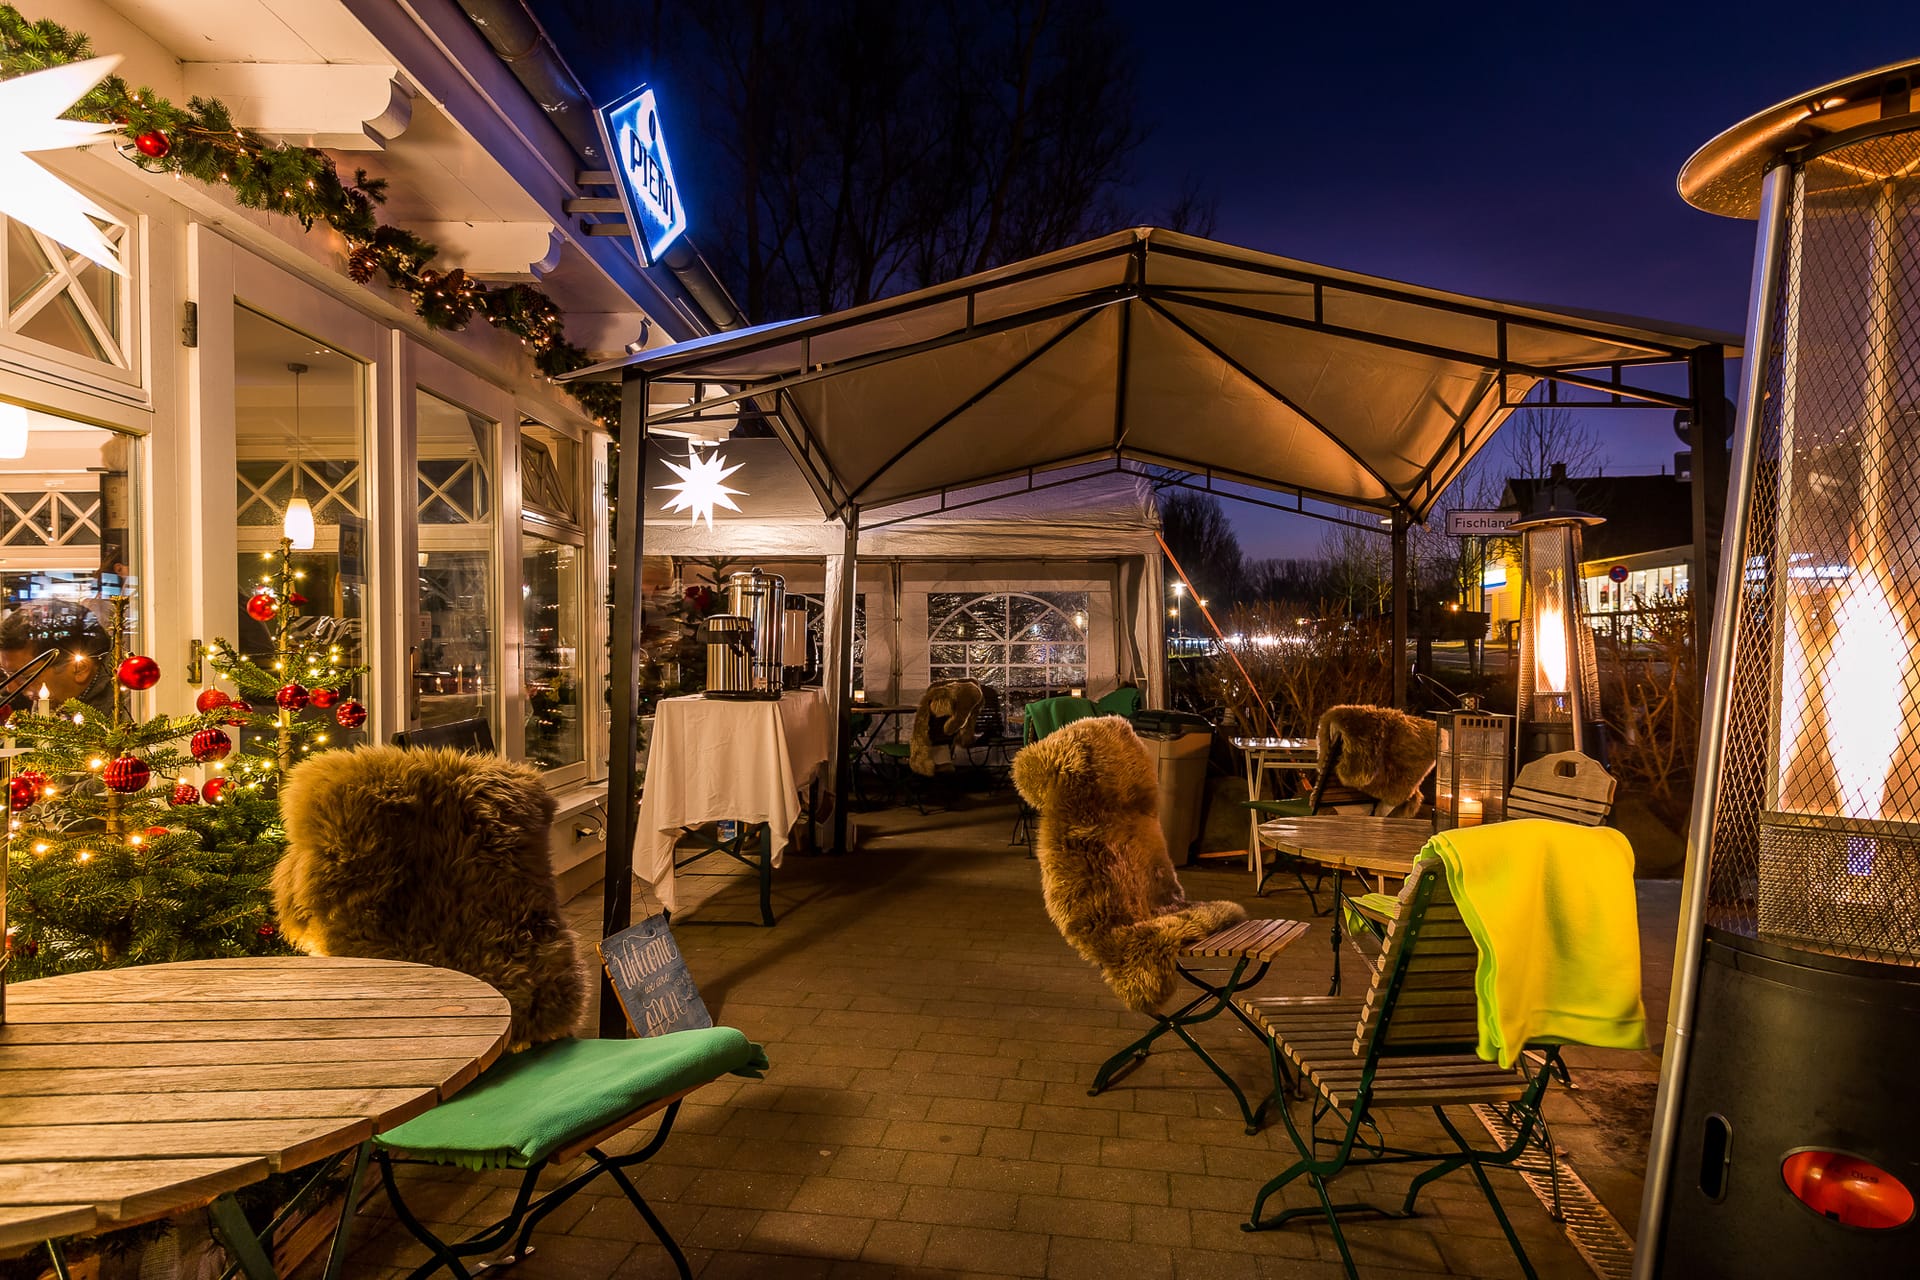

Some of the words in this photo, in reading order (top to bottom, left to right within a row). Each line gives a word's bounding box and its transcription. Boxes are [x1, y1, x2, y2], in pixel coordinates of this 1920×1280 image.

[630, 129, 674, 224] PIENI
[1455, 517, 1513, 529] Fischland
[613, 928, 678, 990] Welcome
